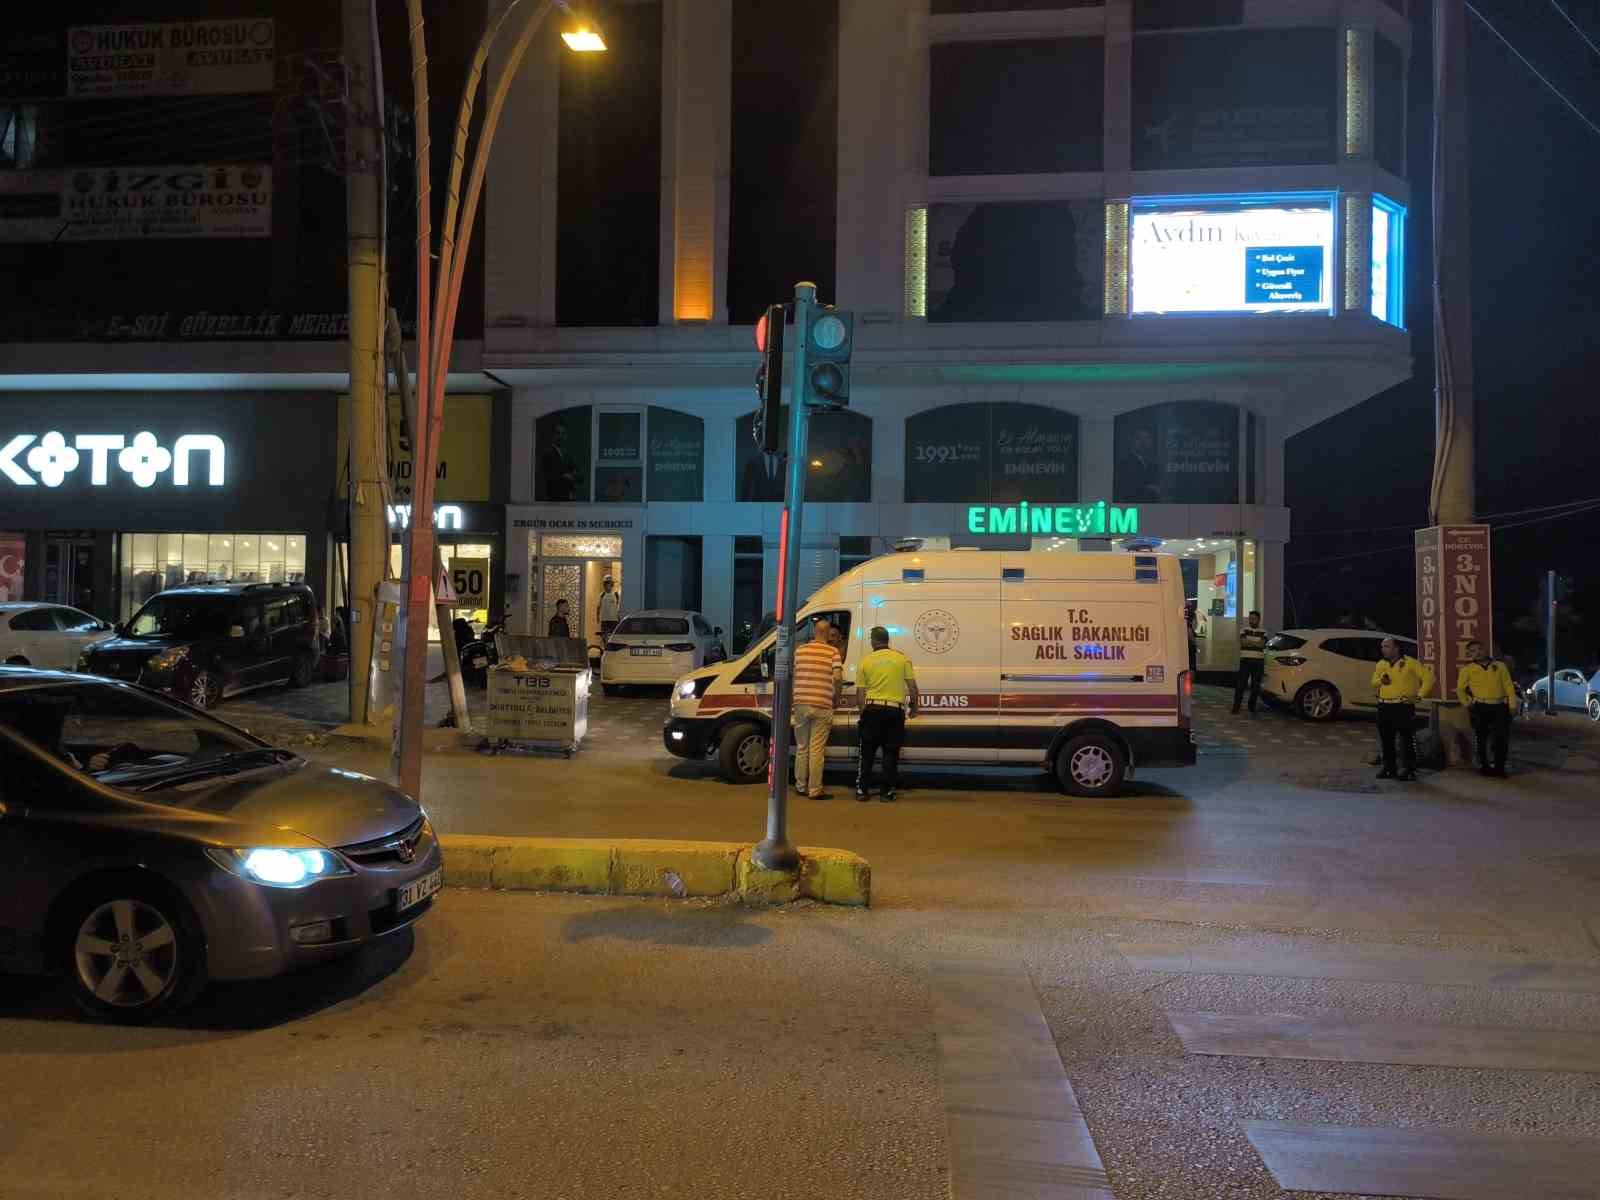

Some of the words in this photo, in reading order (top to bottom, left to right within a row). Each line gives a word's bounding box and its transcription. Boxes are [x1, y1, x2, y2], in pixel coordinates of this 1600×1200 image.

[97, 29, 164, 51] HUKUK
[70, 193, 154, 209] HUKUK
[968, 501, 1138, 533] EMİNEVİM
[454, 570, 483, 595] 50
[1066, 608, 1093, 624] T.C.
[1071, 622, 1150, 642] BAKANLIĞI
[1035, 643, 1068, 660] ACİL
